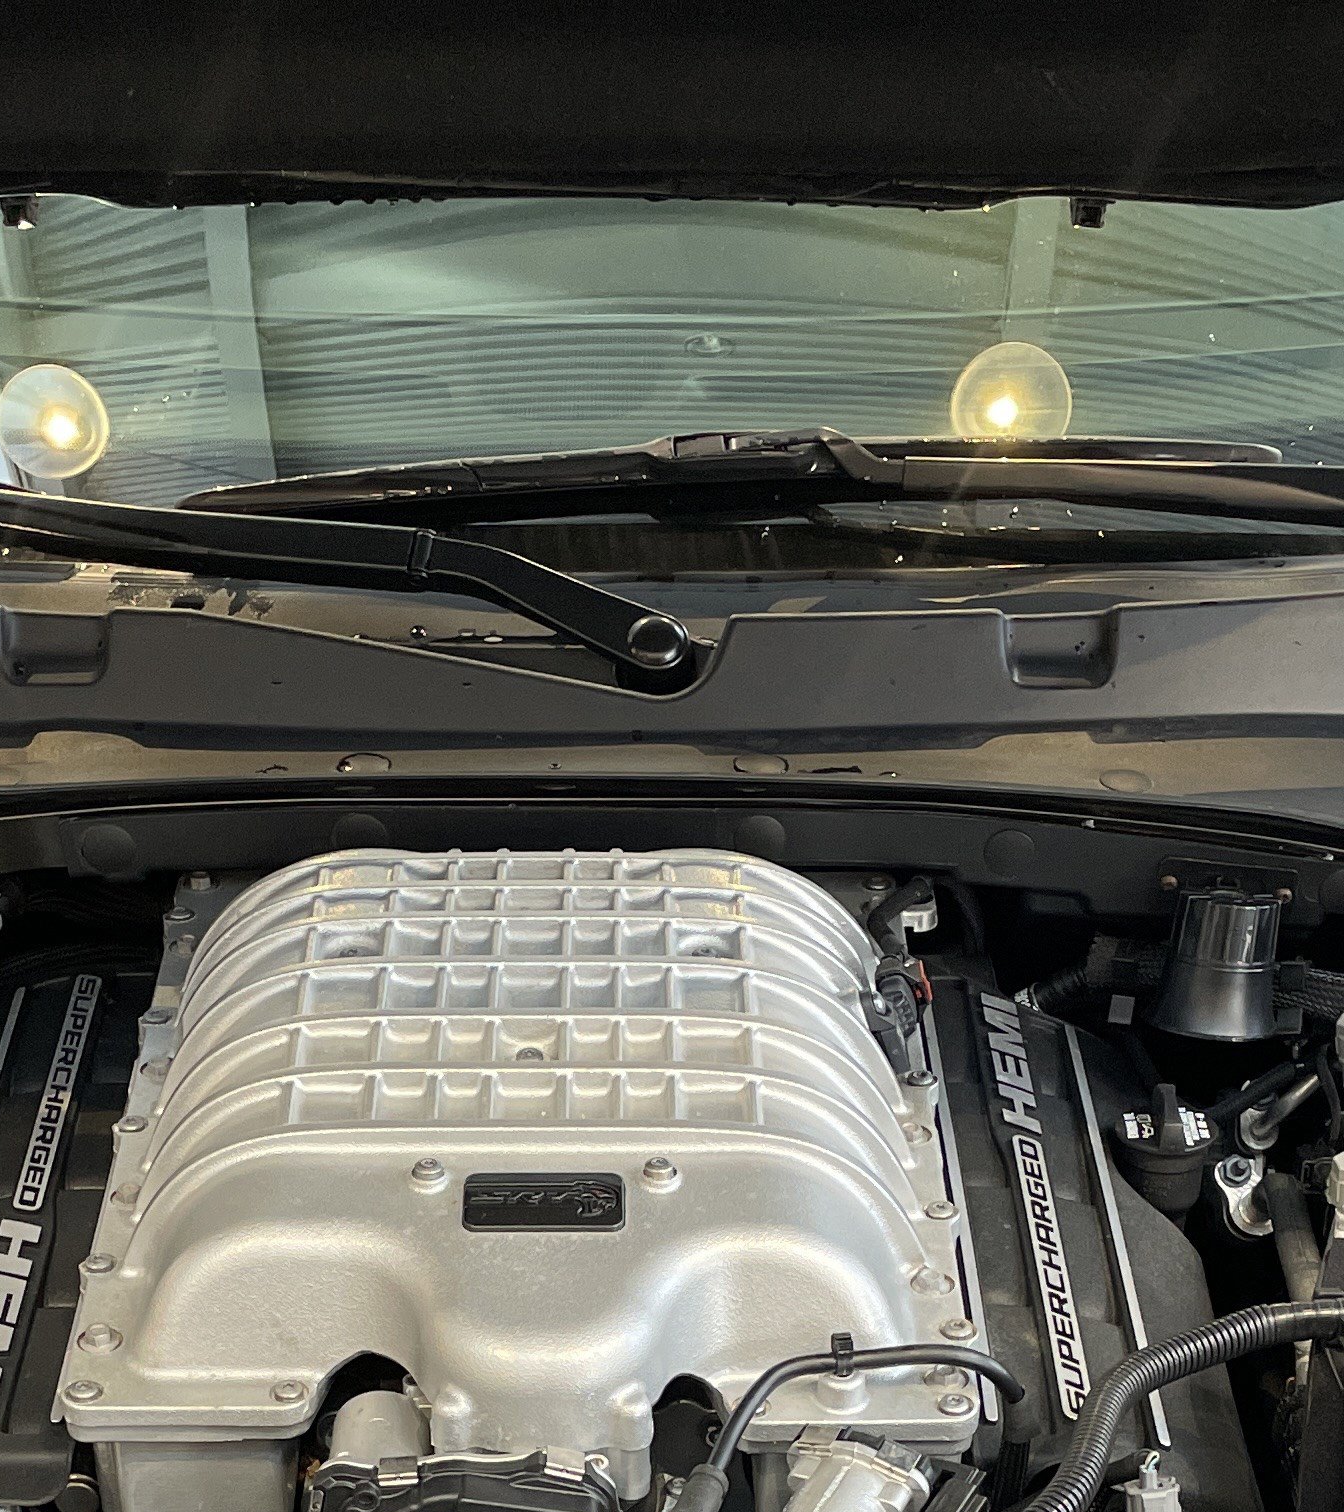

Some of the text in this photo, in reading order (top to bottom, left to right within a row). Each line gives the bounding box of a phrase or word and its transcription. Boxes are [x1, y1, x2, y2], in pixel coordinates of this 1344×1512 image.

[16, 975, 100, 1208] SUPERCHARGED
[980, 992, 1090, 1417] SUPERCHARGED HEMI
